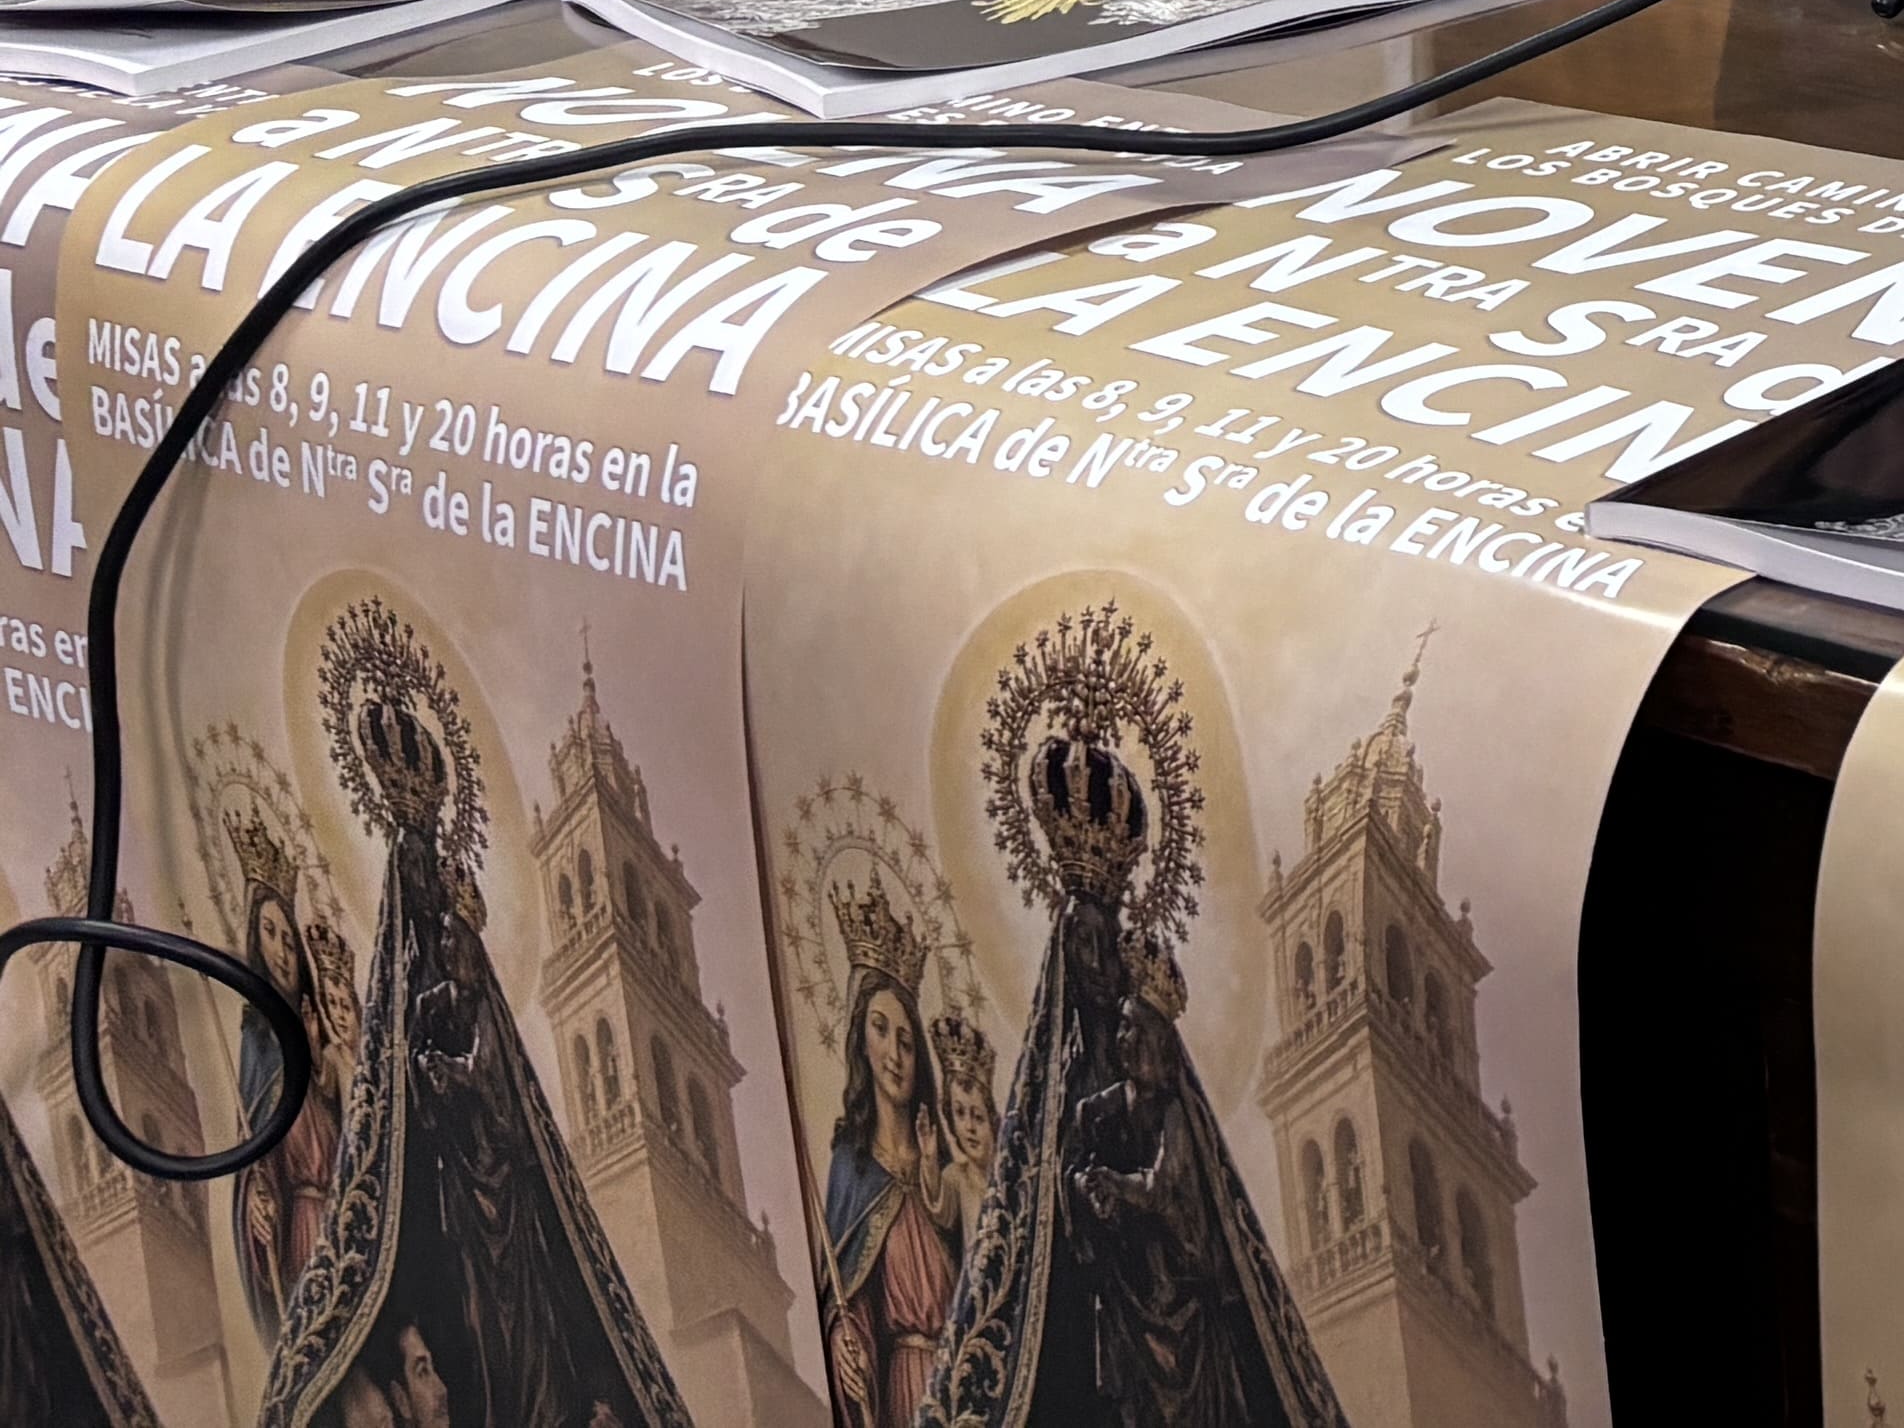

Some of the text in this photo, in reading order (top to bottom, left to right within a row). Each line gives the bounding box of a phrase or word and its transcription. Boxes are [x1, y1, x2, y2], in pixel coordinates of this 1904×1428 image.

[384, 76, 1165, 215] NONA
[946, 93, 1077, 124] MINO
[1545, 139, 1730, 182] ABRIR
[94, 144, 300, 293] LA
[231, 108, 361, 148] a
[313, 115, 584, 170] NTR
[729, 196, 944, 263] de
[1452, 146, 1575, 179] LOS
[1577, 166, 1860, 228] BOSQUES
[911, 250, 1765, 487] LA ENCIN
[1086, 219, 1218, 262] a
[1722, 356, 1894, 418] d
[87, 318, 181, 386] MISAS
[226, 367, 262, 407] as
[269, 363, 299, 428] 8,
[309, 372, 341, 438] 9,
[349, 382, 392, 441] 11
[399, 400, 427, 458] y
[428, 399, 476, 457] 20
[483, 404, 592, 485] horas
[600, 453, 648, 498] en
[660, 443, 699, 510] la
[828, 320, 1587, 536] MISAS a las 8, 9, 11 y 20 horas e
[248, 427, 292, 489] de
[421, 470, 471, 536] de
[480, 481, 518, 549] la
[526, 498, 688, 593] ENCINA
[992, 416, 1072, 478] de
[1244, 473, 1331, 532] de
[1325, 487, 1397, 546] la
[1388, 505, 1646, 600] ENCINA
[0, 615, 48, 658] ras
[4, 666, 94, 734] ENCI
